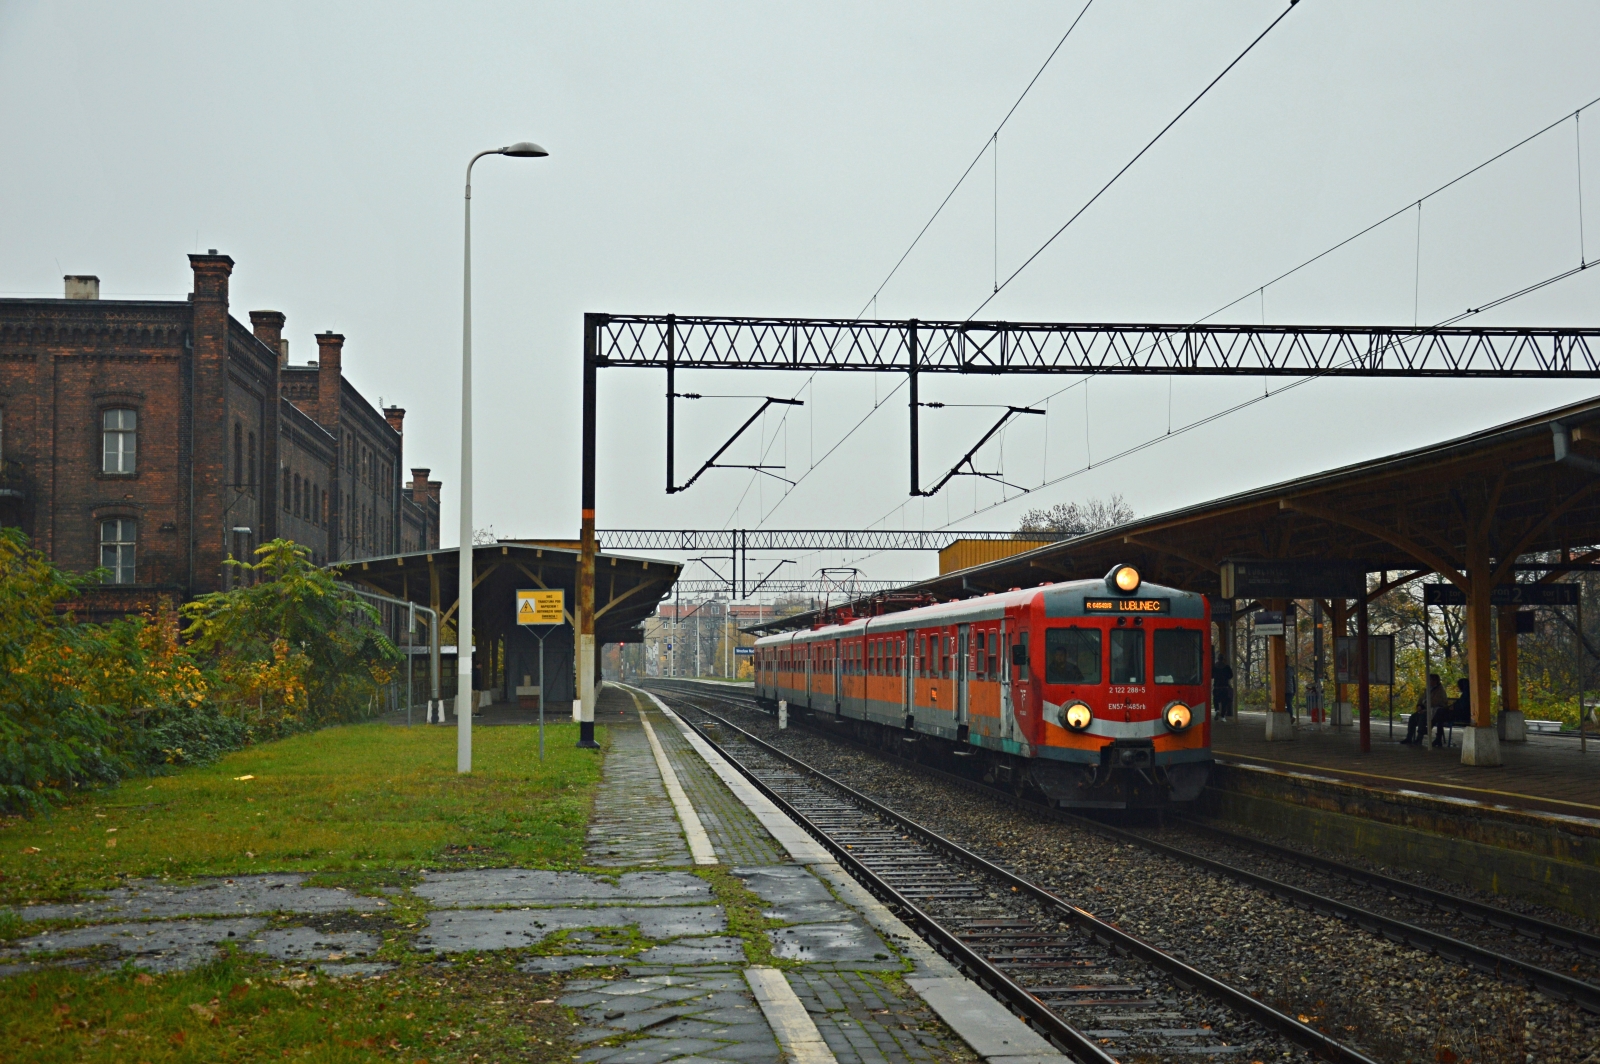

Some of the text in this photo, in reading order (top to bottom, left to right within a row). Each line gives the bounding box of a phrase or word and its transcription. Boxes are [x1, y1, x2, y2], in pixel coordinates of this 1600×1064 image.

[1433, 590, 1442, 603] 2
[1491, 588, 1509, 596] ron
[1512, 587, 1522, 603] 2
[1564, 589, 1571, 602] 1
[1109, 686, 1146, 694] 2 122 288-5
